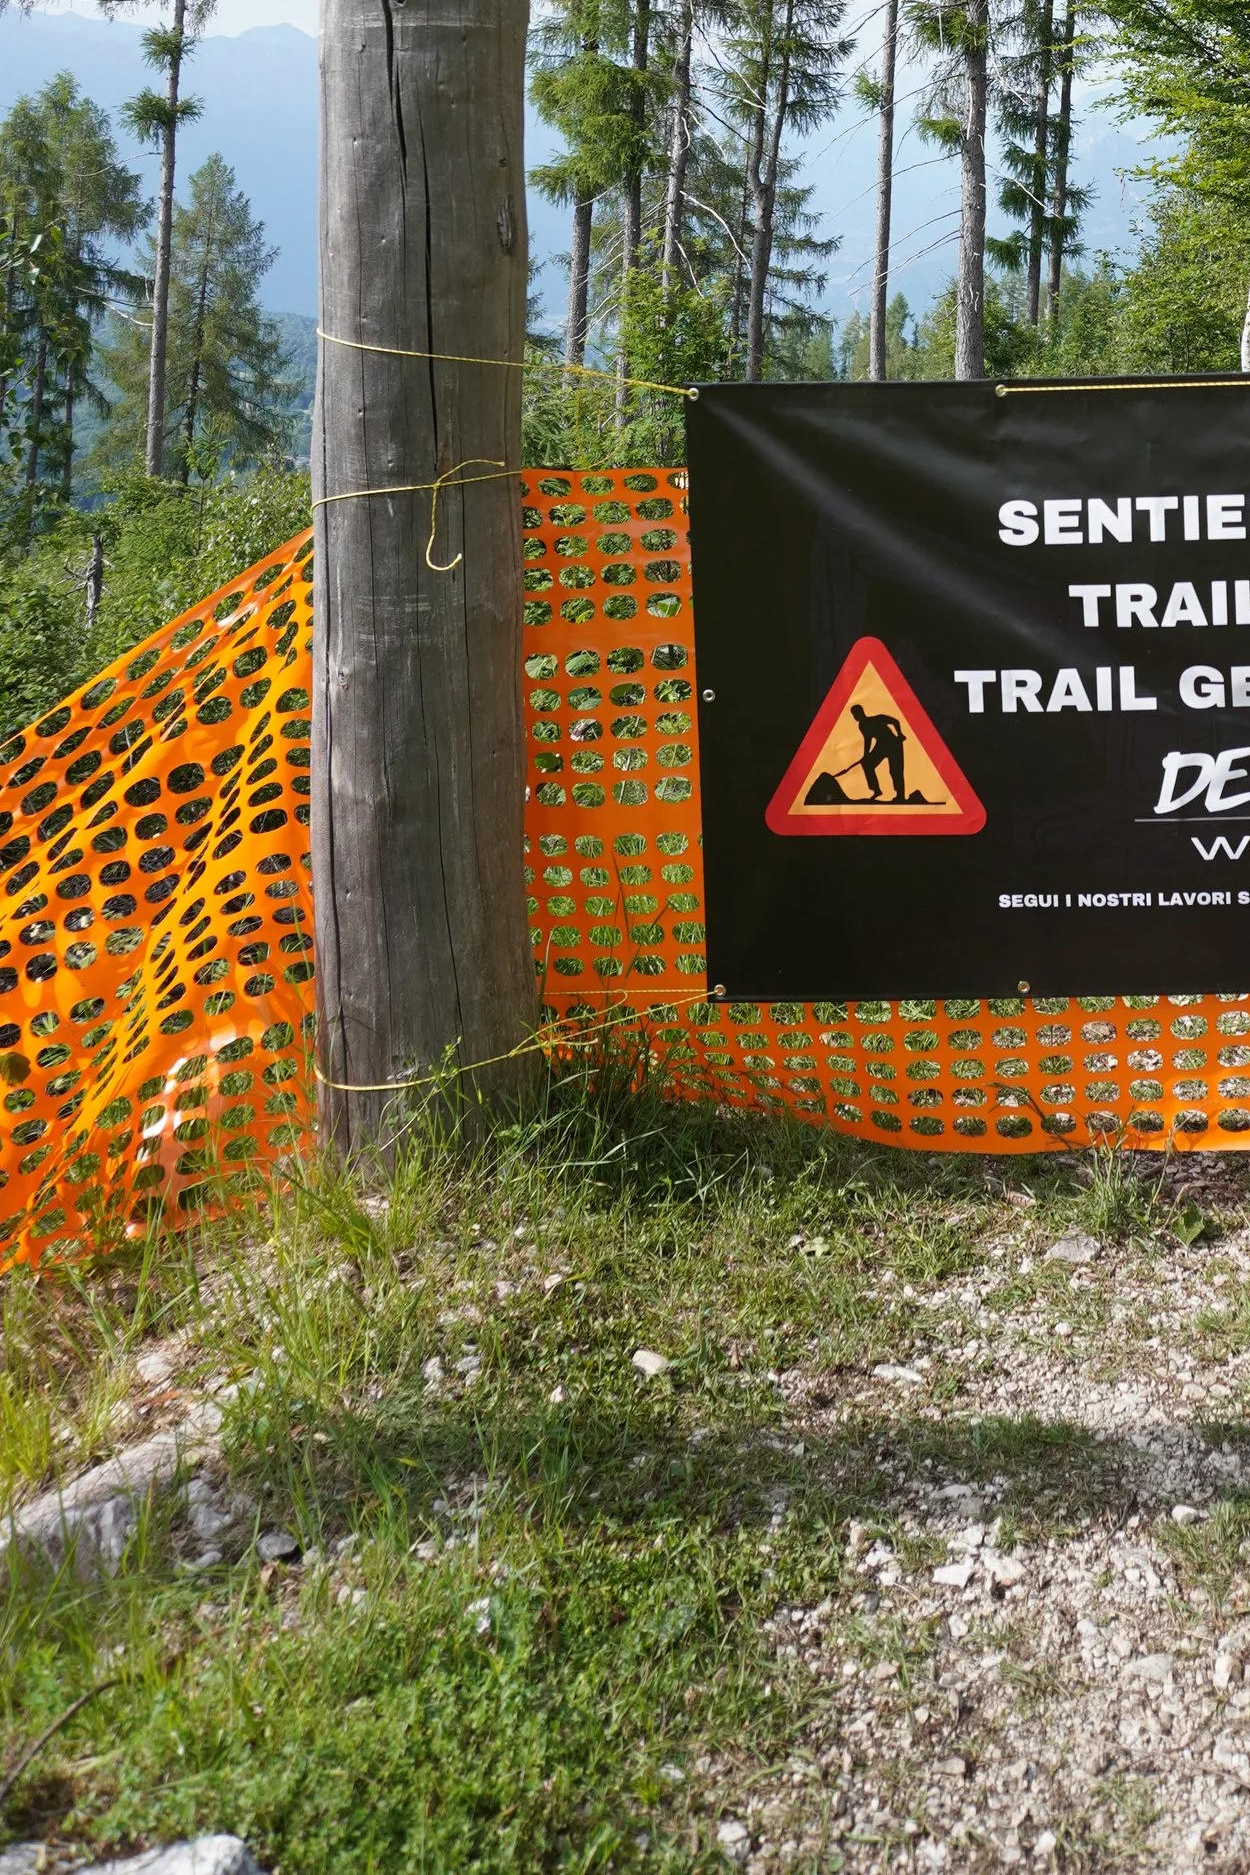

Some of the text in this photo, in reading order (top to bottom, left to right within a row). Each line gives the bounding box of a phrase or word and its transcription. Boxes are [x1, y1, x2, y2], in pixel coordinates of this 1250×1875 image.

[953, 665, 1158, 713] TRAIL
[998, 893, 1059, 908] SEGUI
[1065, 894, 1072, 907] I
[1077, 892, 1152, 907] NOSTRI
[1158, 891, 1232, 906] LAVORI
